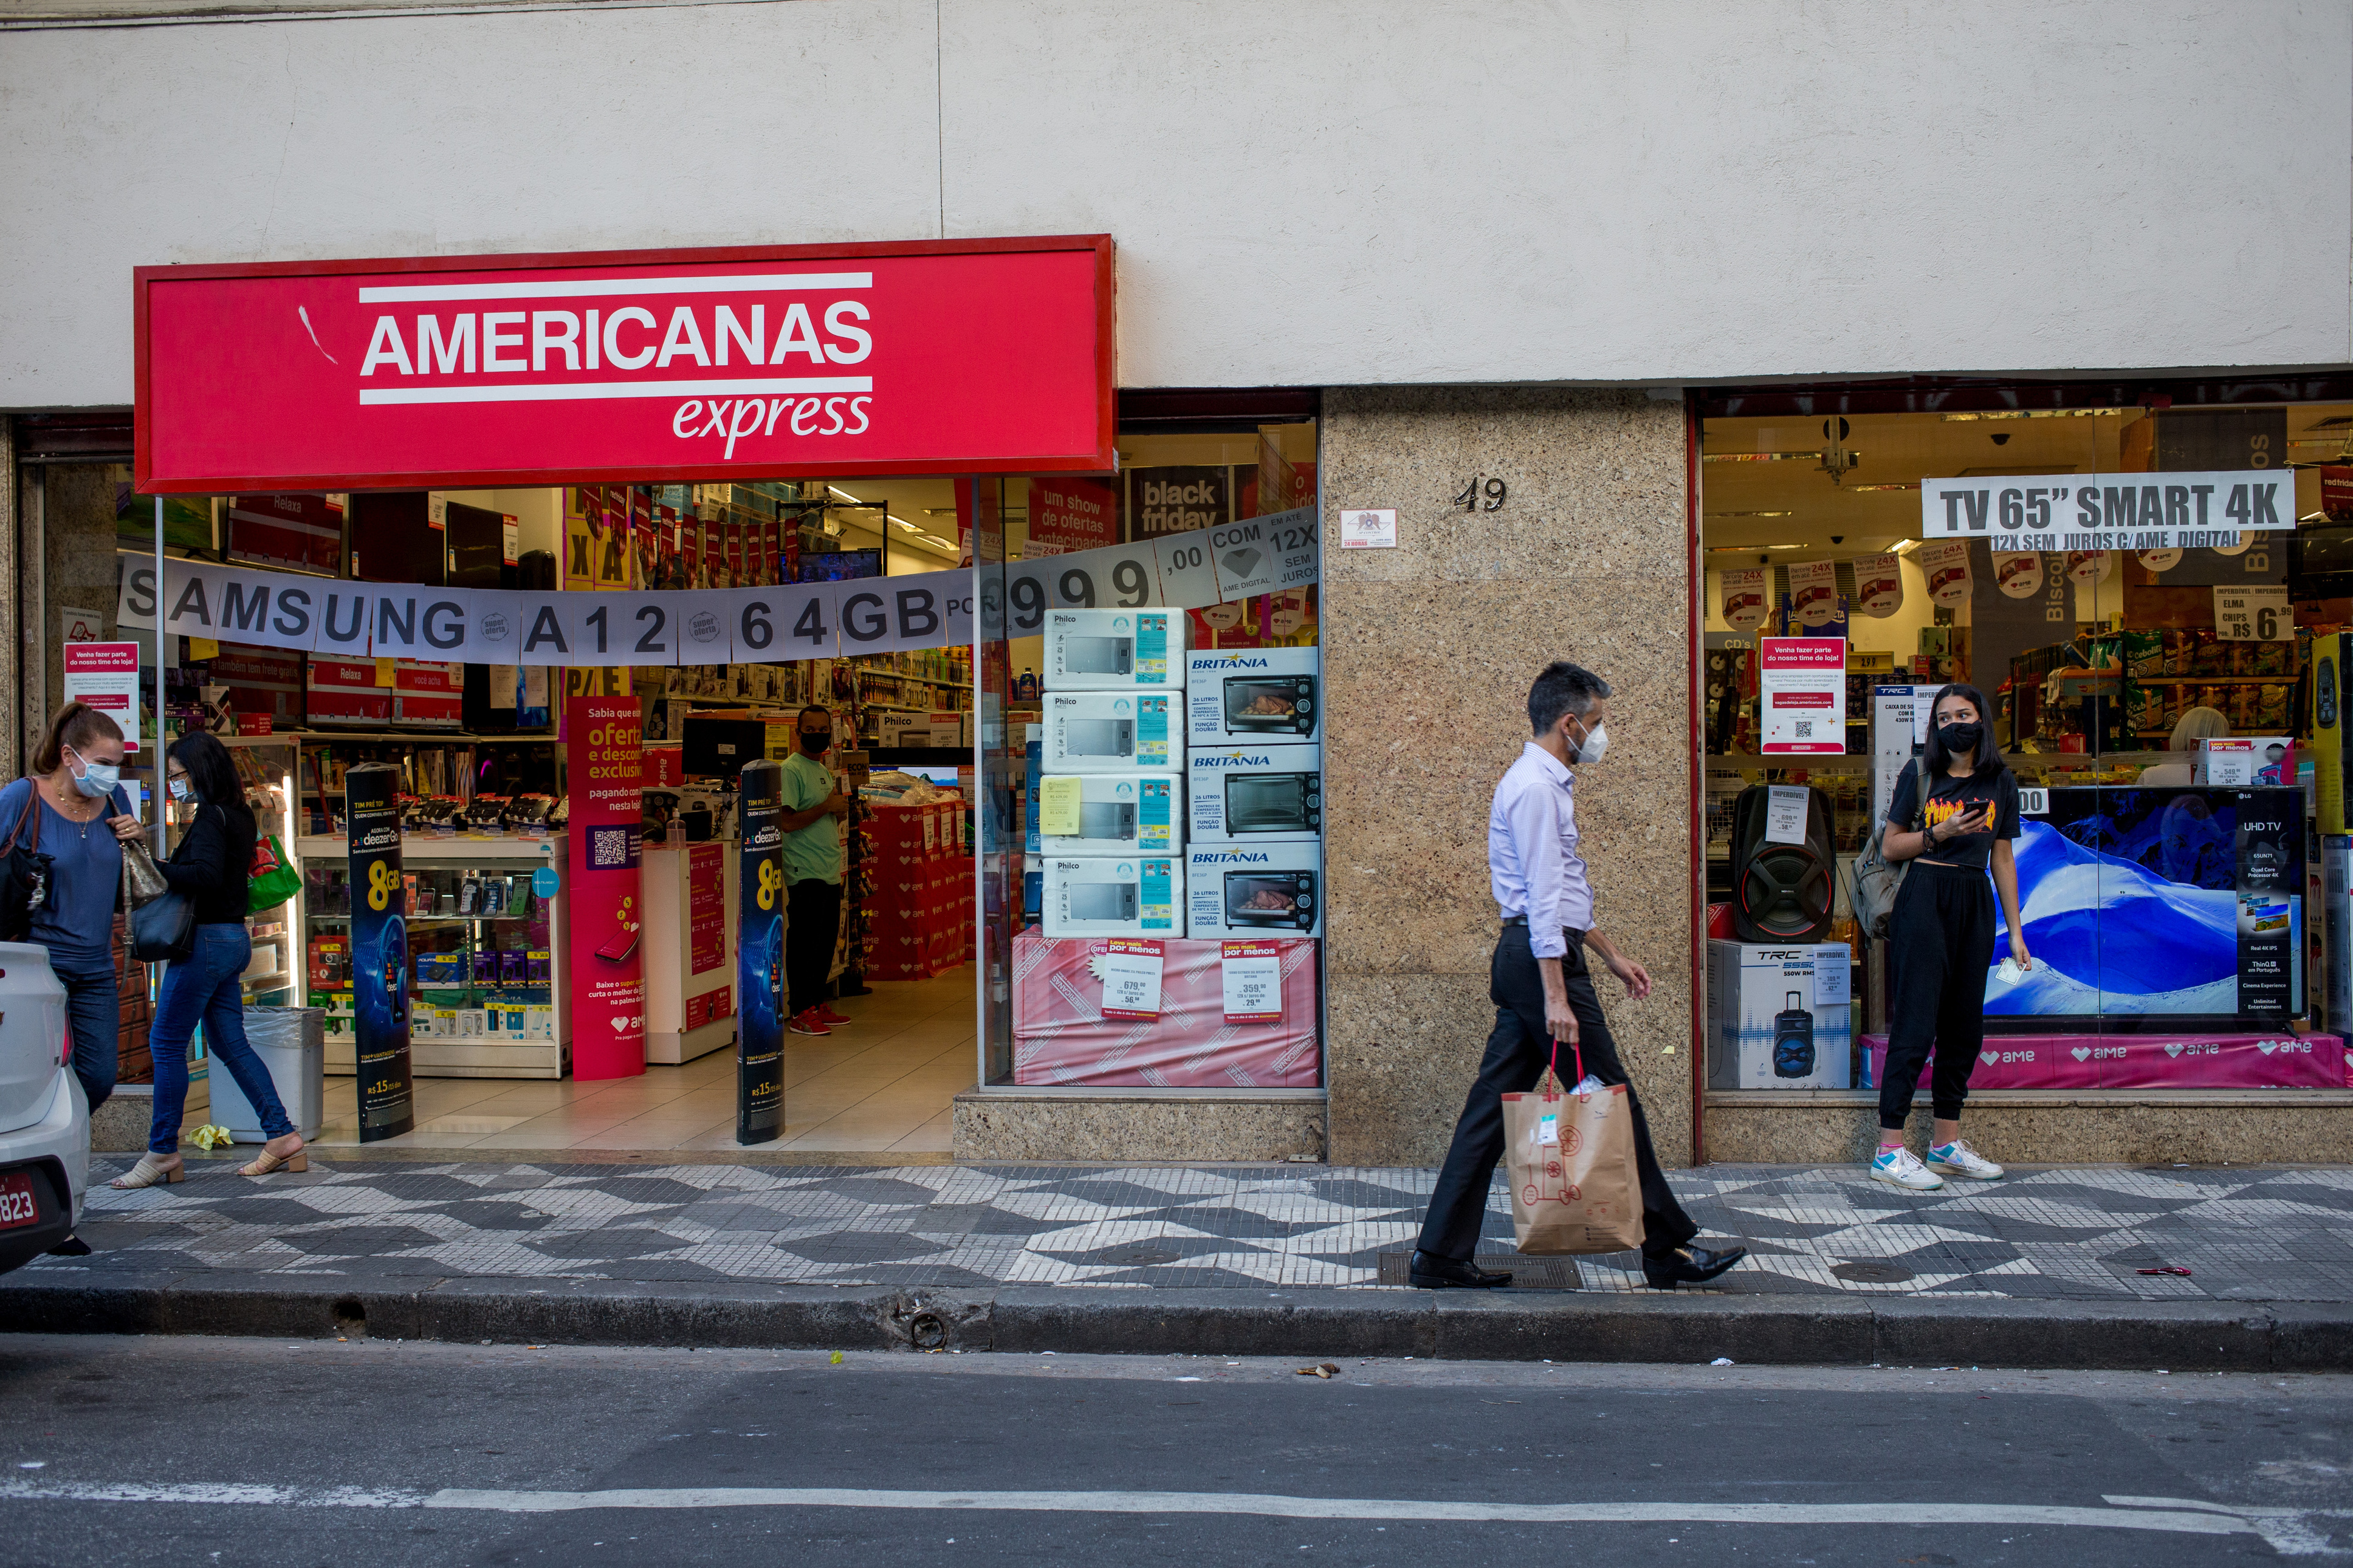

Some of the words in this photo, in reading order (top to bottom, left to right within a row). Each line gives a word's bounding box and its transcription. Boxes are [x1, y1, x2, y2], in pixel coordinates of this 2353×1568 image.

[360, 301, 873, 376] AMERICANAS
[673, 396, 873, 460] express
[1144, 482, 1215, 506] black
[1454, 477, 1507, 512] 49
[274, 495, 301, 513] Relaxa
[1043, 490, 1065, 506] um
[1067, 491, 1101, 515] show
[1940, 490, 1990, 530] TV
[2076, 484, 2214, 529] SMART
[2225, 483, 2279, 525] 4K
[1042, 510, 1058, 527] de
[1060, 512, 1104, 533] ofertas
[1142, 506, 1216, 532] friday
[1285, 512, 1302, 522] ATÉ
[1037, 530, 1111, 549] antecipadas
[1269, 524, 1318, 553] 12X
[1991, 535, 2019, 552] 12X
[2023, 534, 2056, 550] SEM
[2063, 533, 2112, 550] JUROS
[2177, 530, 2239, 548] DIGITAL
[1285, 553, 1311, 567] SEM
[1280, 566, 1319, 583] JUROS
[1812, 563, 1832, 573] 24X
[1743, 570, 1763, 580] 24X
[126, 569, 465, 649] SAMSUNG
[523, 605, 665, 653] A12
[946, 595, 997, 617] POR
[1212, 524, 1261, 548] COM
[1223, 584, 1240, 593] AME
[1241, 577, 1271, 589] DIGITAL
[2223, 600, 2245, 608] ELMA
[484, 618, 504, 628] super
[693, 617, 714, 628] super
[2222, 612, 2247, 622] CHIPS
[485, 626, 506, 635] oferta
[693, 625, 716, 636] oferta
[2233, 623, 2251, 638] R$
[218, 659, 246, 673] também
[248, 662, 261, 673] tem
[262, 662, 278, 675] frete
[279, 666, 298, 679] grátis
[1192, 658, 1268, 669] BRITANIA
[340, 668, 362, 680] Relaxa
[414, 676, 427, 684] você
[428, 677, 441, 685] acha
[588, 708, 615, 717] Sabia
[617, 710, 632, 719] que
[884, 716, 912, 726] Philco
[1194, 756, 1270, 767] BRITANIA
[589, 787, 628, 799] pagando
[1772, 789, 1805, 799] IMPERDÍVEL
[365, 799, 376, 808] PRÉ
[609, 799, 631, 810] nesta
[2244, 822, 2265, 831] UHD
[2266, 822, 2281, 831] TV
[363, 833, 390, 846] deezer
[755, 830, 775, 844] deezer
[1192, 852, 1269, 863] BRITANIA
[368, 860, 400, 911] 8GB
[757, 858, 782, 910] 8GB
[1757, 950, 1802, 960] TRC
[596, 980, 614, 988] Baixe
[1124, 981, 1146, 991] 679,00
[1243, 984, 1266, 993] 359,90
[588, 989, 606, 998] curta
[613, 987, 633, 996] melhor
[1051, 973, 1089, 1014] AMERICANAS
[619, 996, 635, 1006] palma
[1085, 1010, 1104, 1028] LOJAS
[1133, 1022, 1152, 1038] LOJAS
[1097, 1036, 1134, 1072] AMERICANAS
[1274, 1038, 1311, 1073] AMERICANAS
[2002, 1049, 2035, 1063] ame
[2094, 1046, 2126, 1060] ame
[0, 1191, 34, 1222] 823
